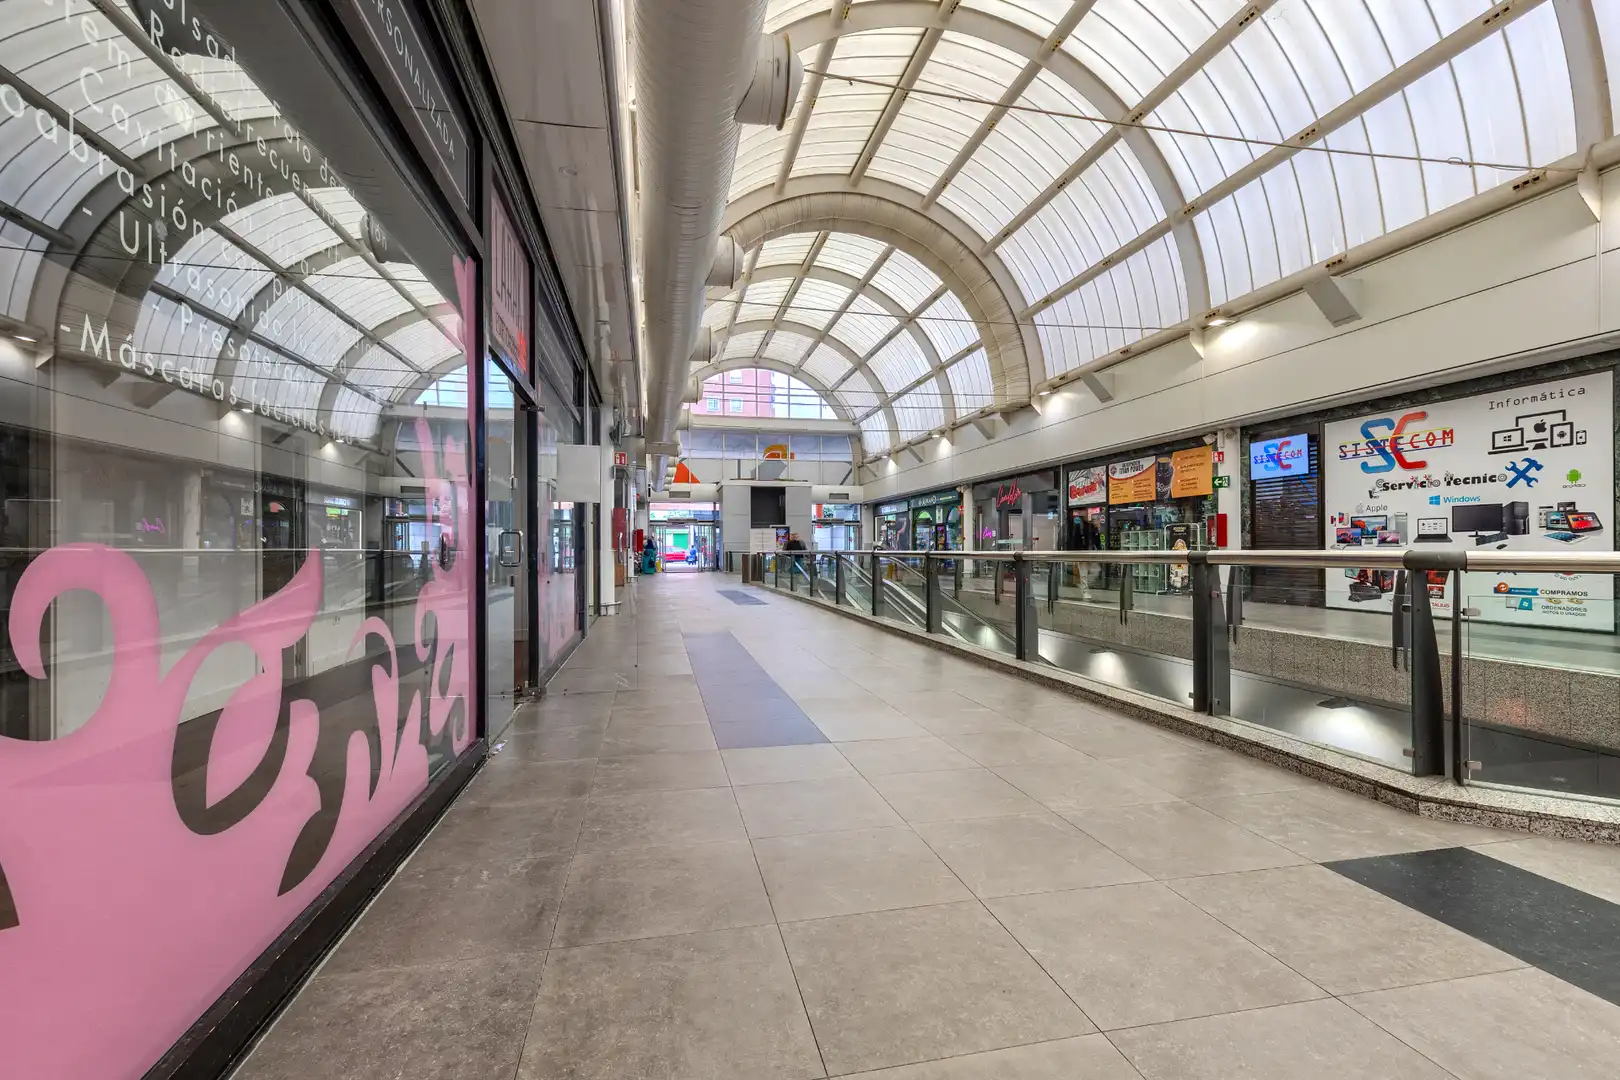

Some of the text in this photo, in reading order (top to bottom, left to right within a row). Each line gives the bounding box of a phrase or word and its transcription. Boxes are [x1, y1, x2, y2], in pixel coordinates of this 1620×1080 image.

[372, 0, 455, 160] RSONALIZADA
[79, 66, 252, 233] Cavitación
[119, 212, 281, 337] Ultrasonido
[80, 313, 237, 406] Máscaras
[251, 380, 324, 436] faciales
[1488, 387, 1586, 410] Informática
[1365, 504, 1388, 513] Apple
[1443, 494, 1481, 504] Windows
[1540, 589, 1588, 597] COMPRAMOS
[1541, 605, 1588, 613] ORDENADORES
